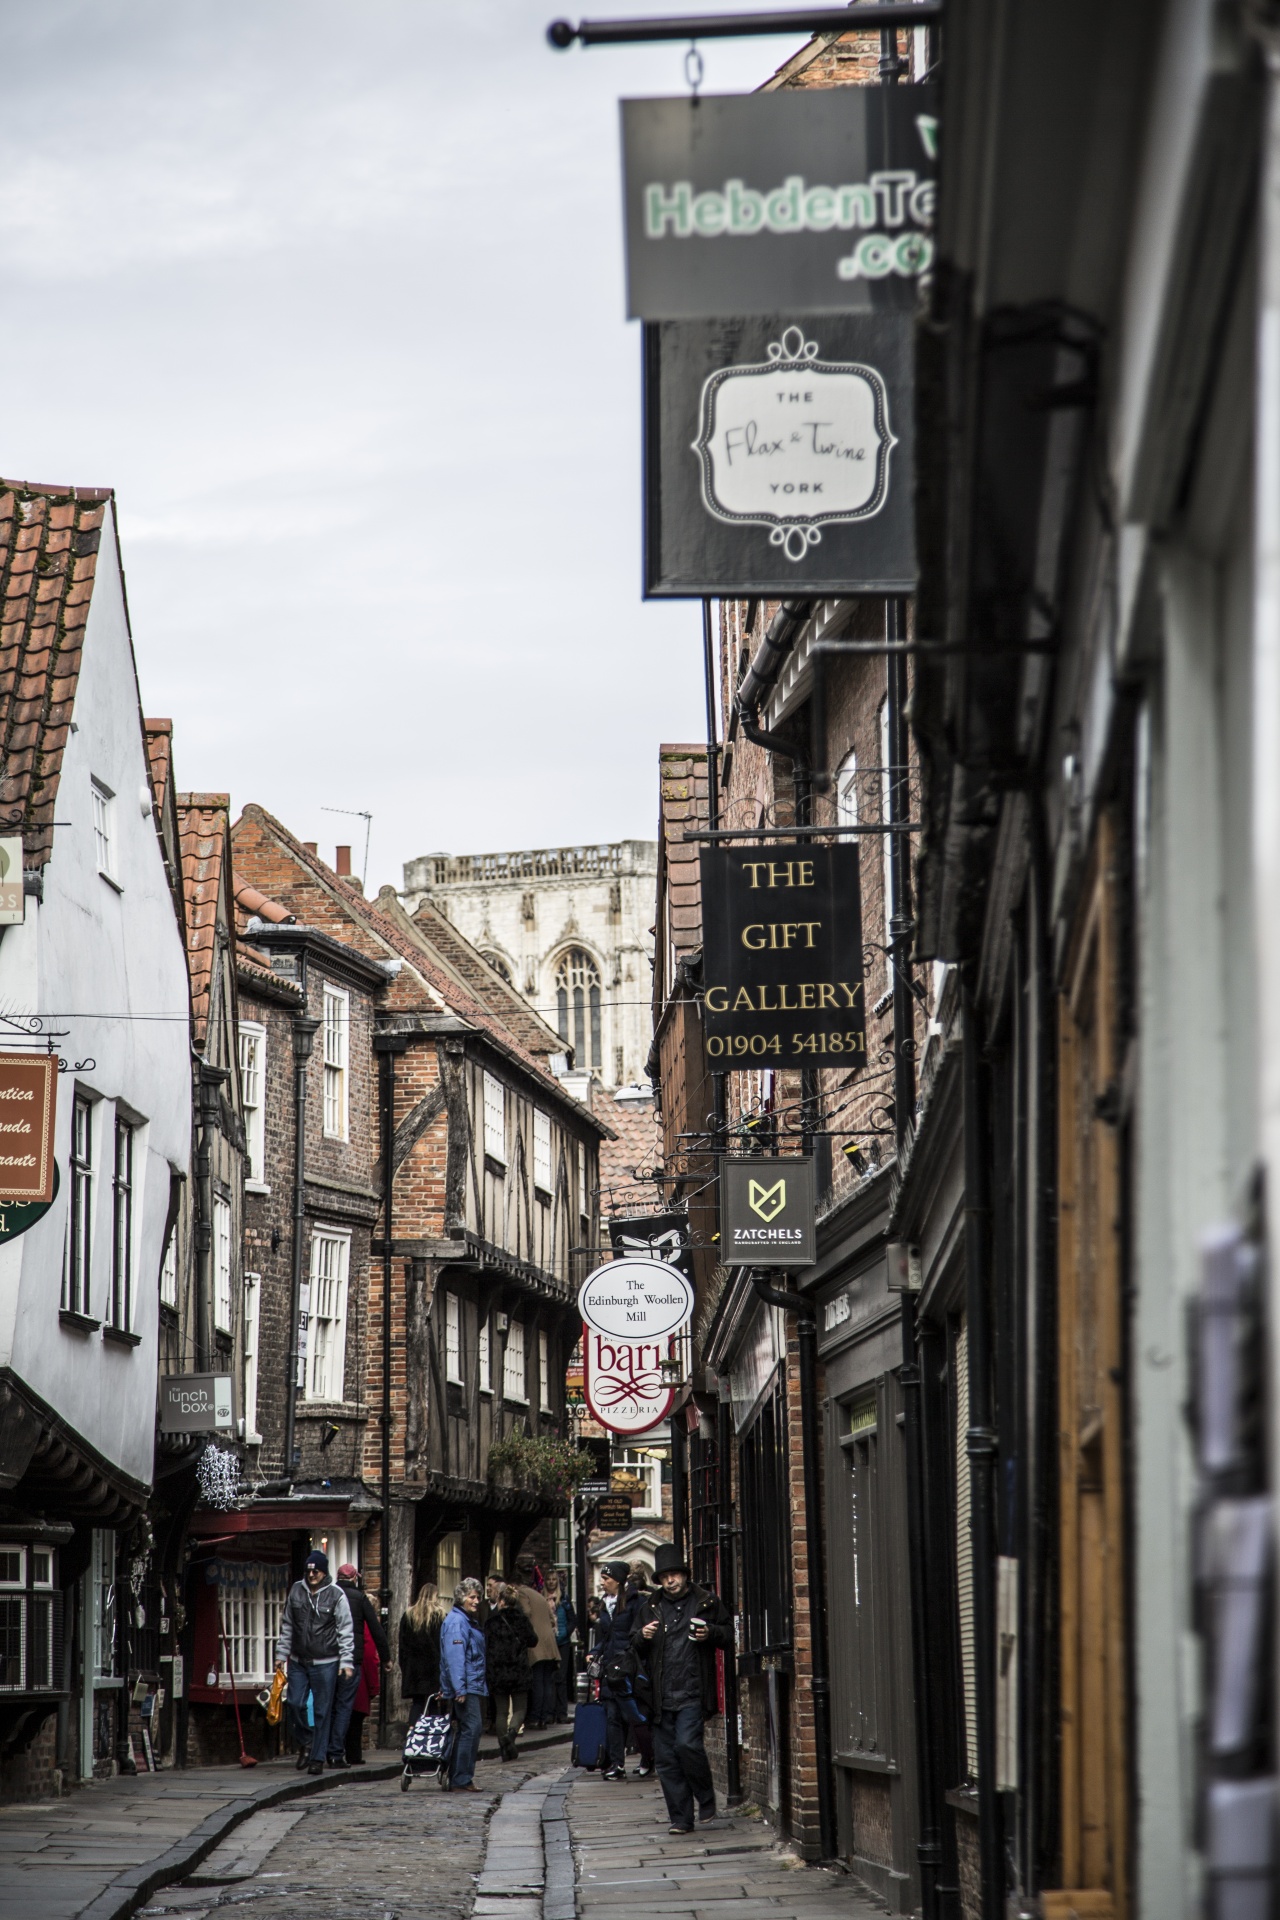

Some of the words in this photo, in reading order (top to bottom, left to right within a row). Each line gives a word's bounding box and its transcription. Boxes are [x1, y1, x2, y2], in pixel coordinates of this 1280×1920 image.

[776, 391, 814, 403] THE
[725, 419, 784, 466] Flax
[790, 431, 802, 443] &
[801, 421, 866, 461] Twine
[769, 482, 824, 494] YORK
[742, 861, 815, 888] THE
[741, 922, 821, 950] GIFT
[705, 982, 863, 1012] GALLERY
[706, 1034, 782, 1057] 01904
[792, 1031, 866, 1054] 541851
[733, 1229, 803, 1239] ZATCHELS
[626, 1280, 645, 1290] The
[588, 1295, 639, 1308] Edinburgh
[644, 1294, 684, 1304] Woollen
[626, 1312, 647, 1322] Mill
[169, 1389, 208, 1402] lunch
[218, 1409, 230, 1417] 37
[600, 1406, 659, 1414] PIZZERIA
